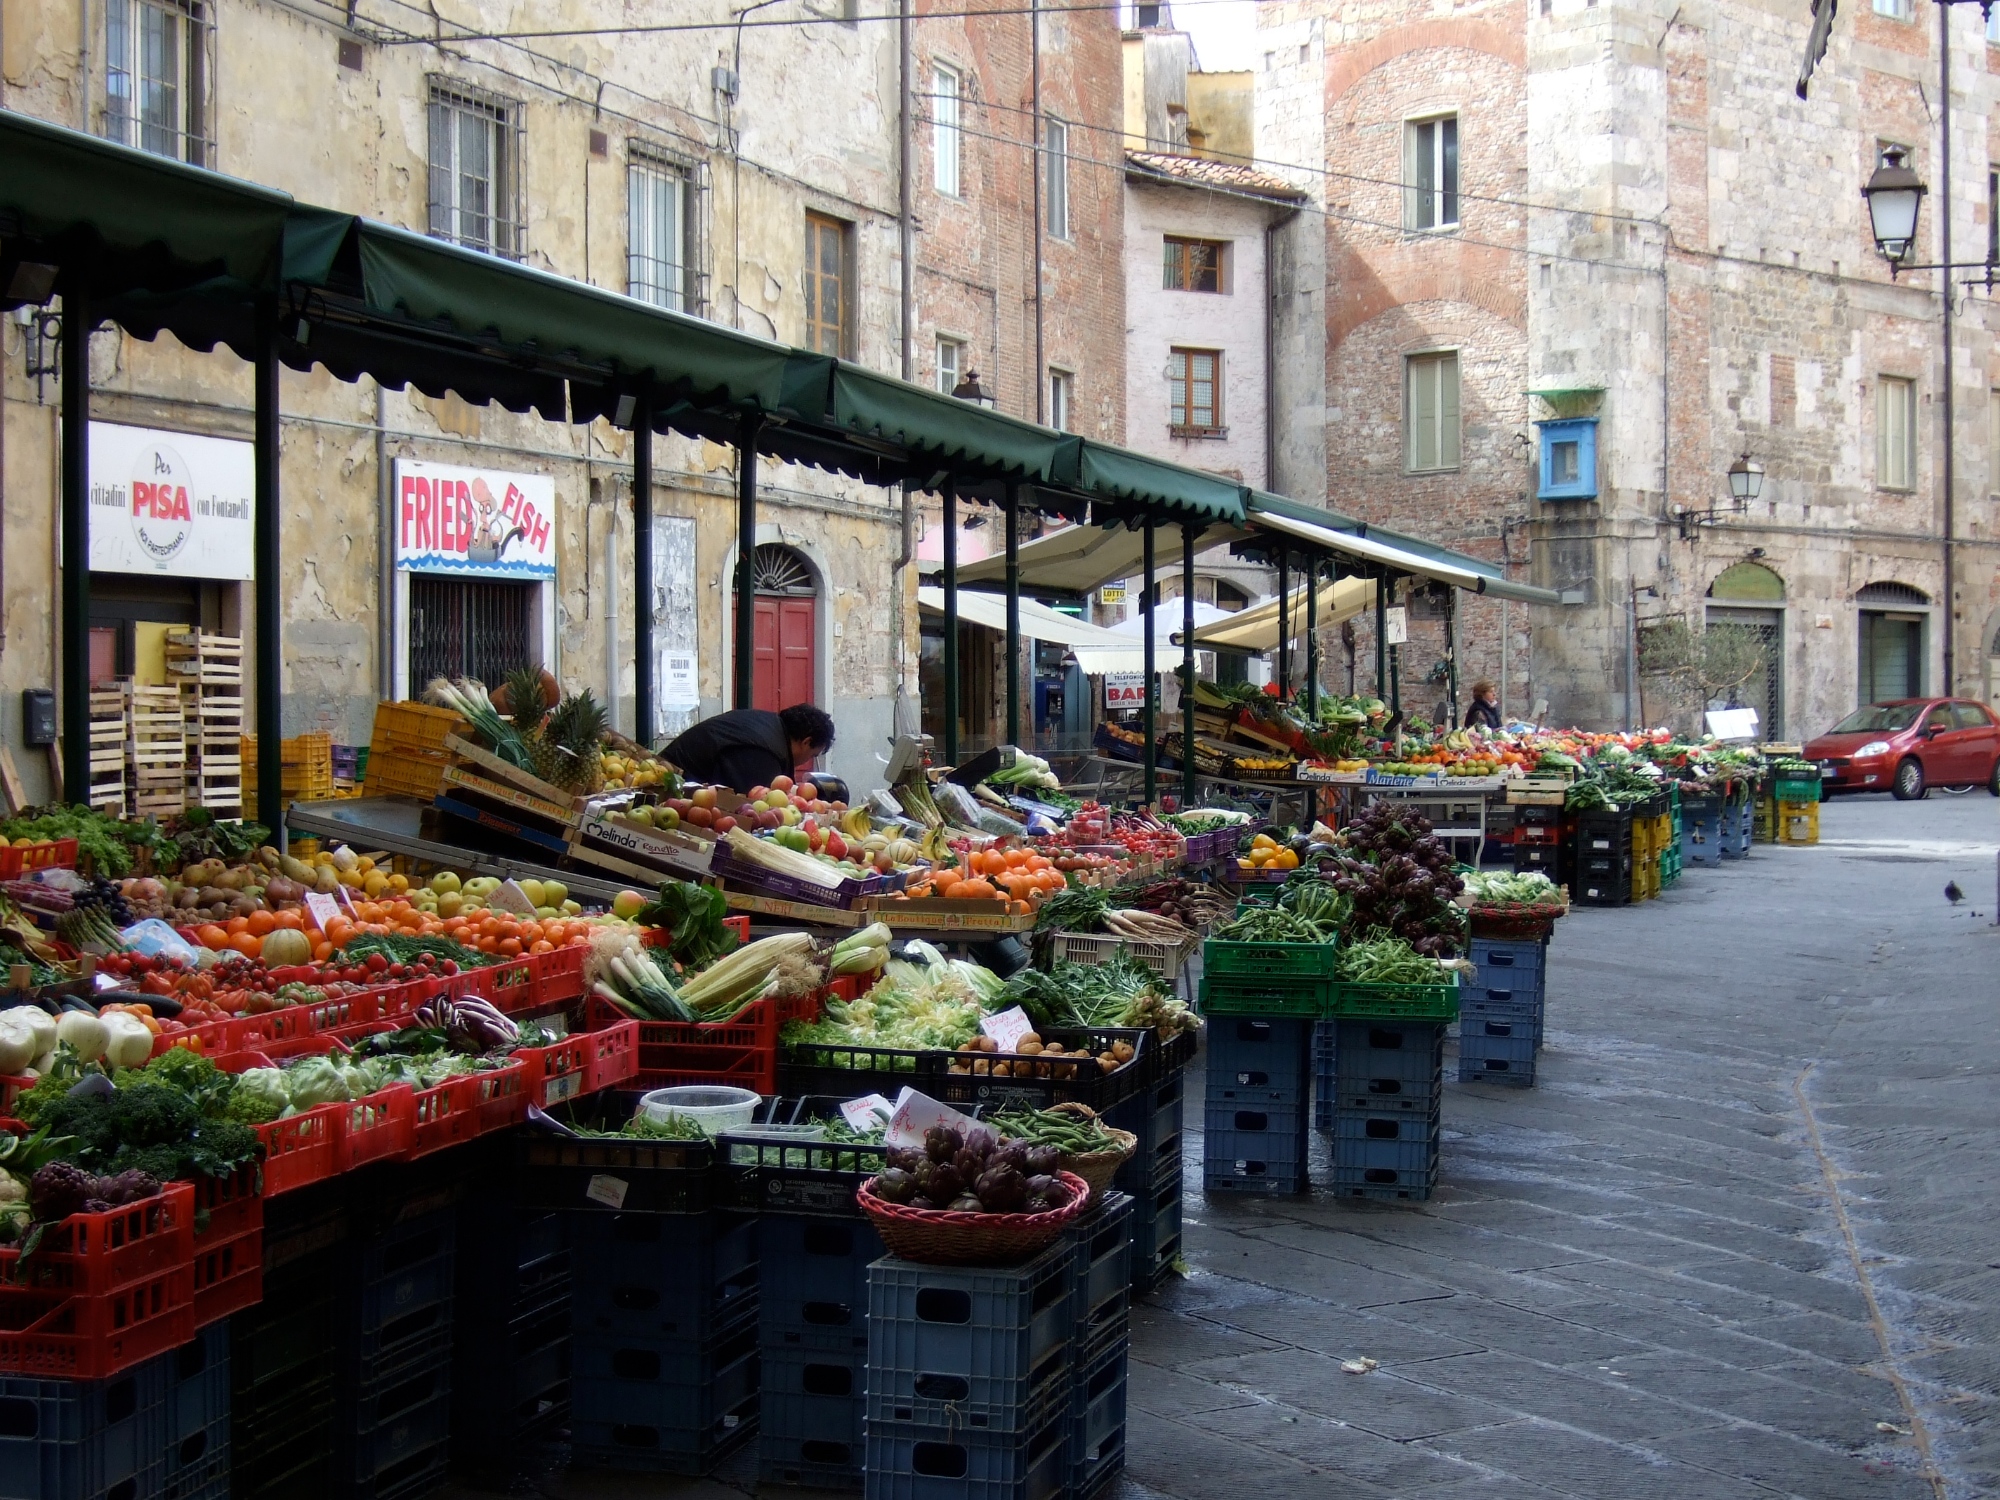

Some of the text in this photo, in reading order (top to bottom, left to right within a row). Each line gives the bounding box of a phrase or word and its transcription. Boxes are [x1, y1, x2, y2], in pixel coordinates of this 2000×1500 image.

[154, 451, 172, 475] Per
[91, 482, 126, 508] cittadini
[132, 481, 192, 522] PISA
[197, 494, 249, 520] con Fontanelli
[402, 475, 551, 554] FRIED FISH
[1299, 772, 1331, 781] Melinda
[1368, 774, 1414, 787] Marlene
[586, 822, 679, 855] Melinda Renetta
[898, 914, 943, 925] Boutique
[965, 917, 1000, 926] Frutta
